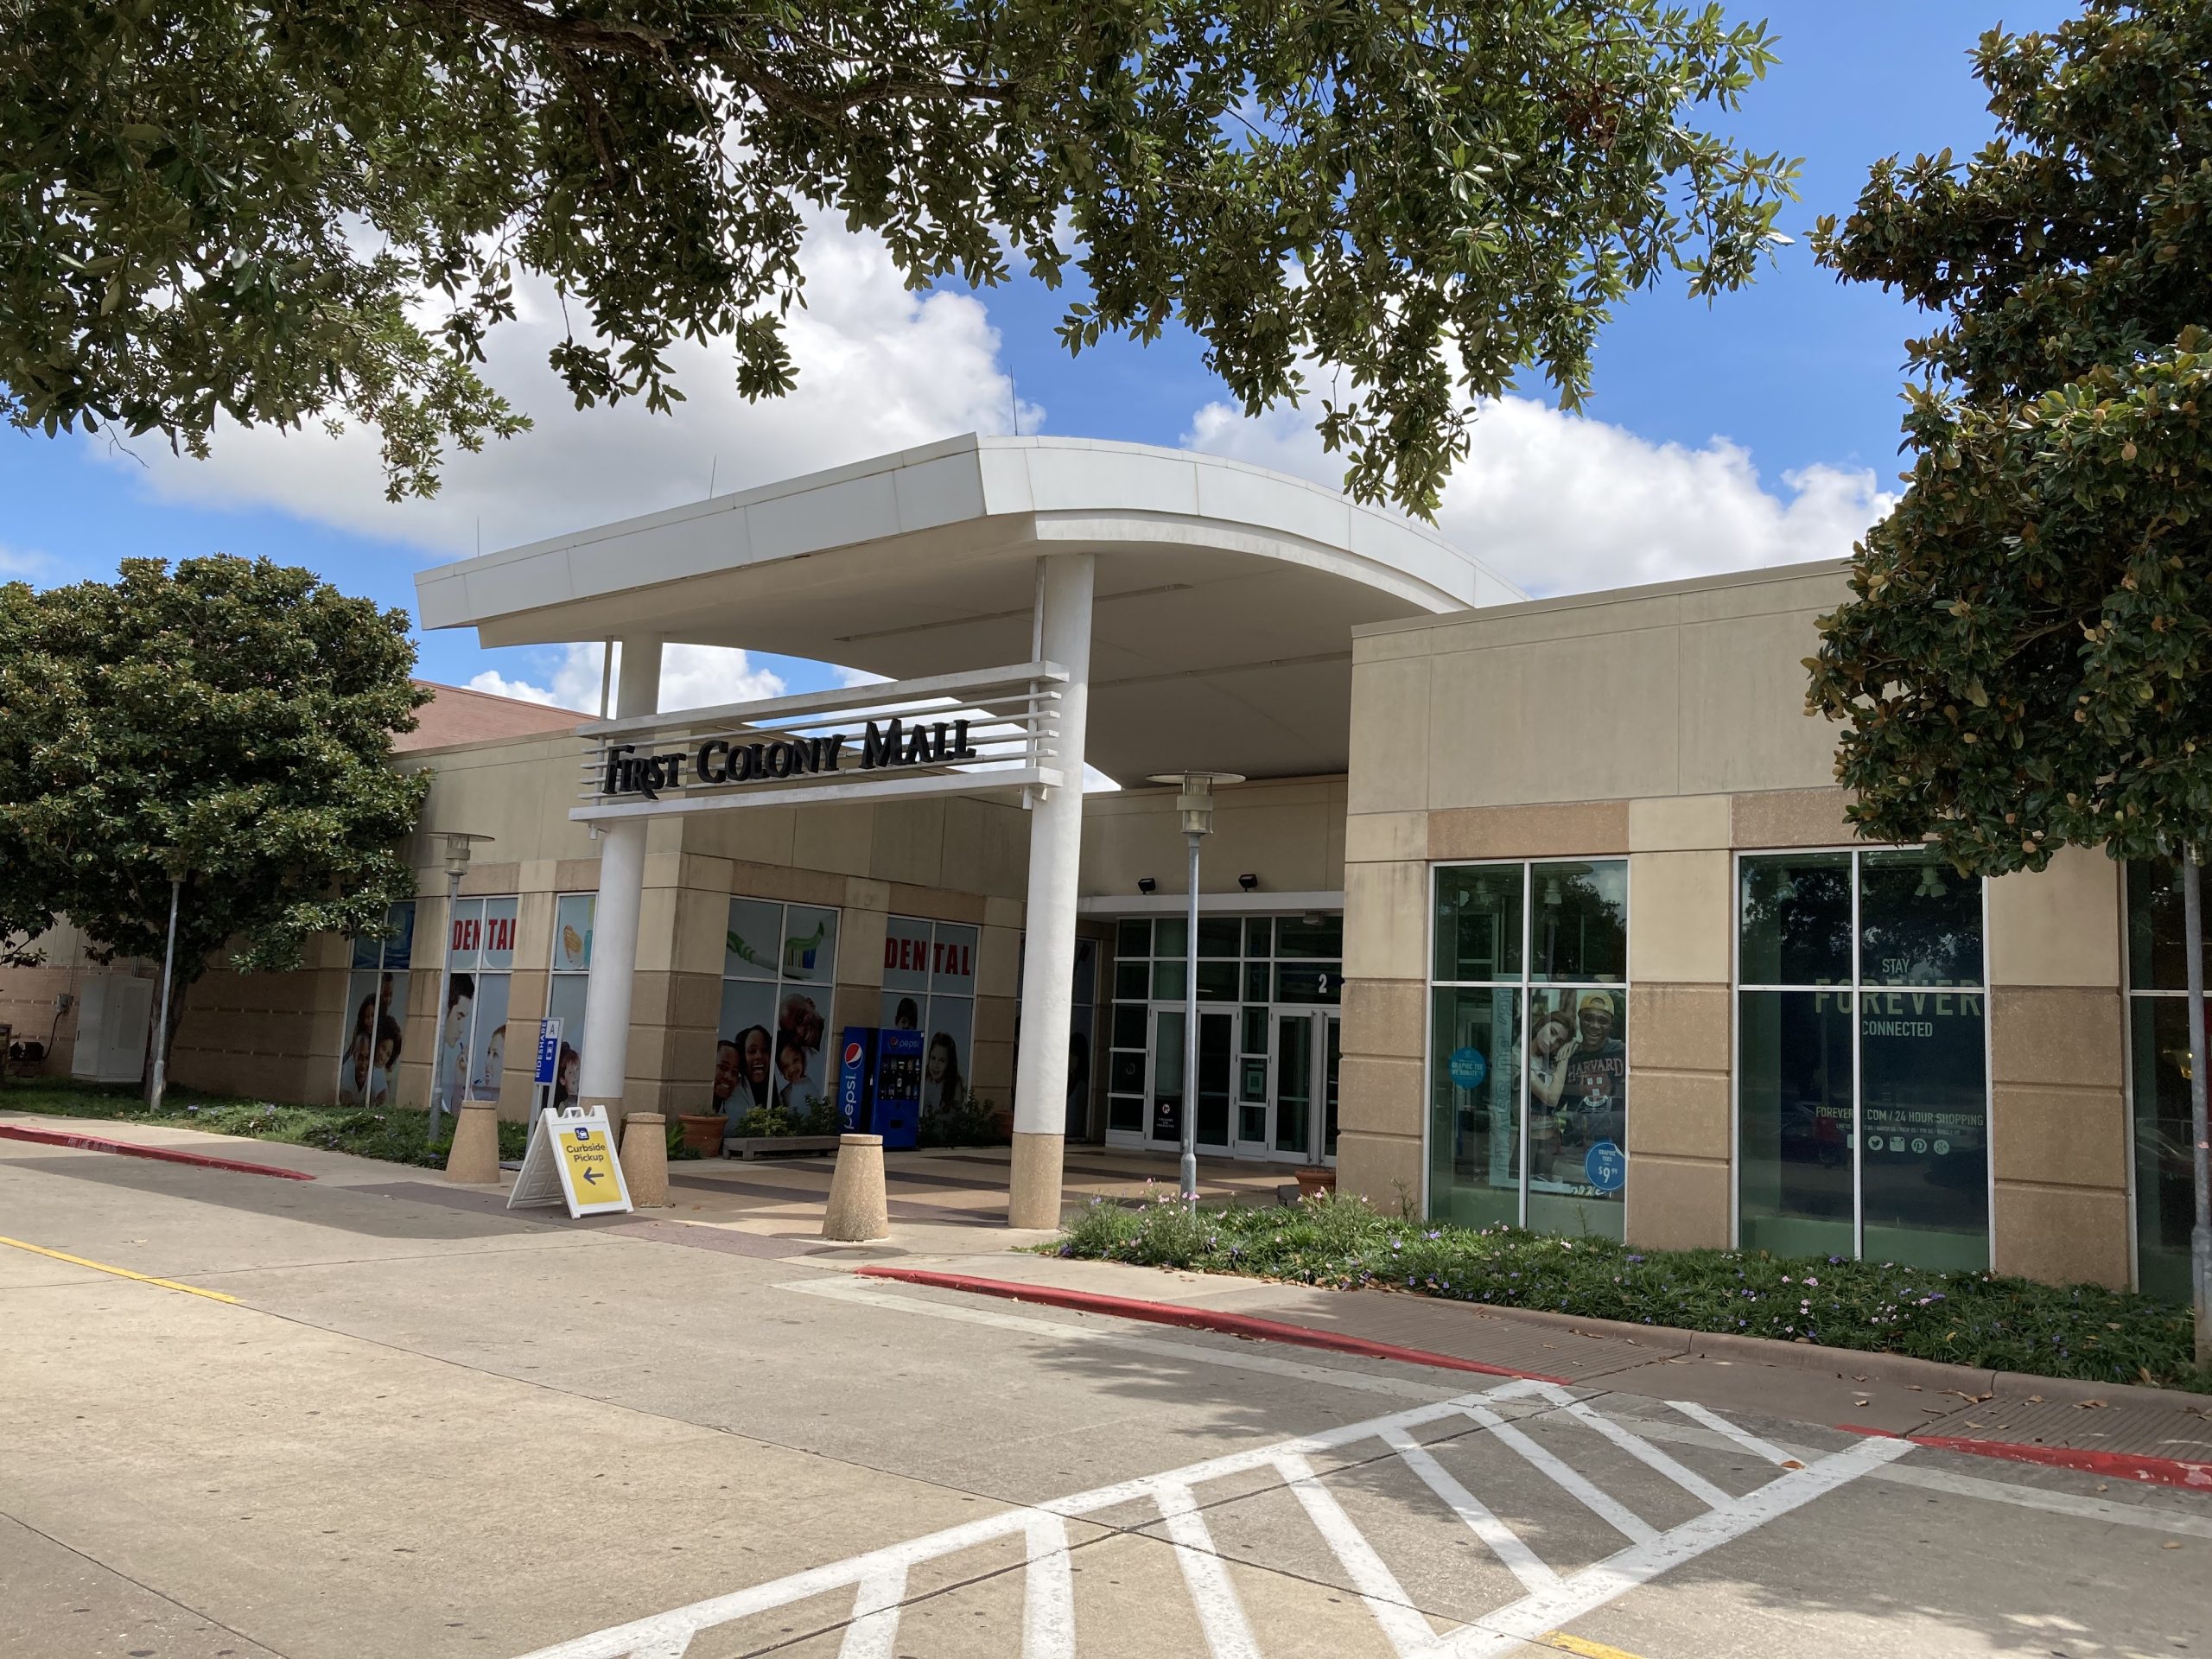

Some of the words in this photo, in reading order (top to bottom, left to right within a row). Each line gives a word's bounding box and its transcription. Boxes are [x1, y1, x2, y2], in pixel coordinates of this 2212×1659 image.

[884, 937, 971, 976] DENTAL
[1882, 958, 1910, 974] STAY
[1319, 973, 1327, 994] 2
[1815, 978, 1981, 1016] FOREVER
[550, 1024, 555, 1035] A
[1862, 1020, 1933, 1037] CONNECTED
[535, 1021, 547, 1078] RIDESHARE
[899, 1039, 920, 1049] pepsi
[1567, 1058, 1624, 1083] HARVARD
[1895, 1111, 1906, 1122] 24
[1909, 1112, 1934, 1123] HOUR
[1936, 1112, 1984, 1126] SHOPPING
[566, 1143, 606, 1153] Curbside
[574, 1154, 604, 1163] Pickup
